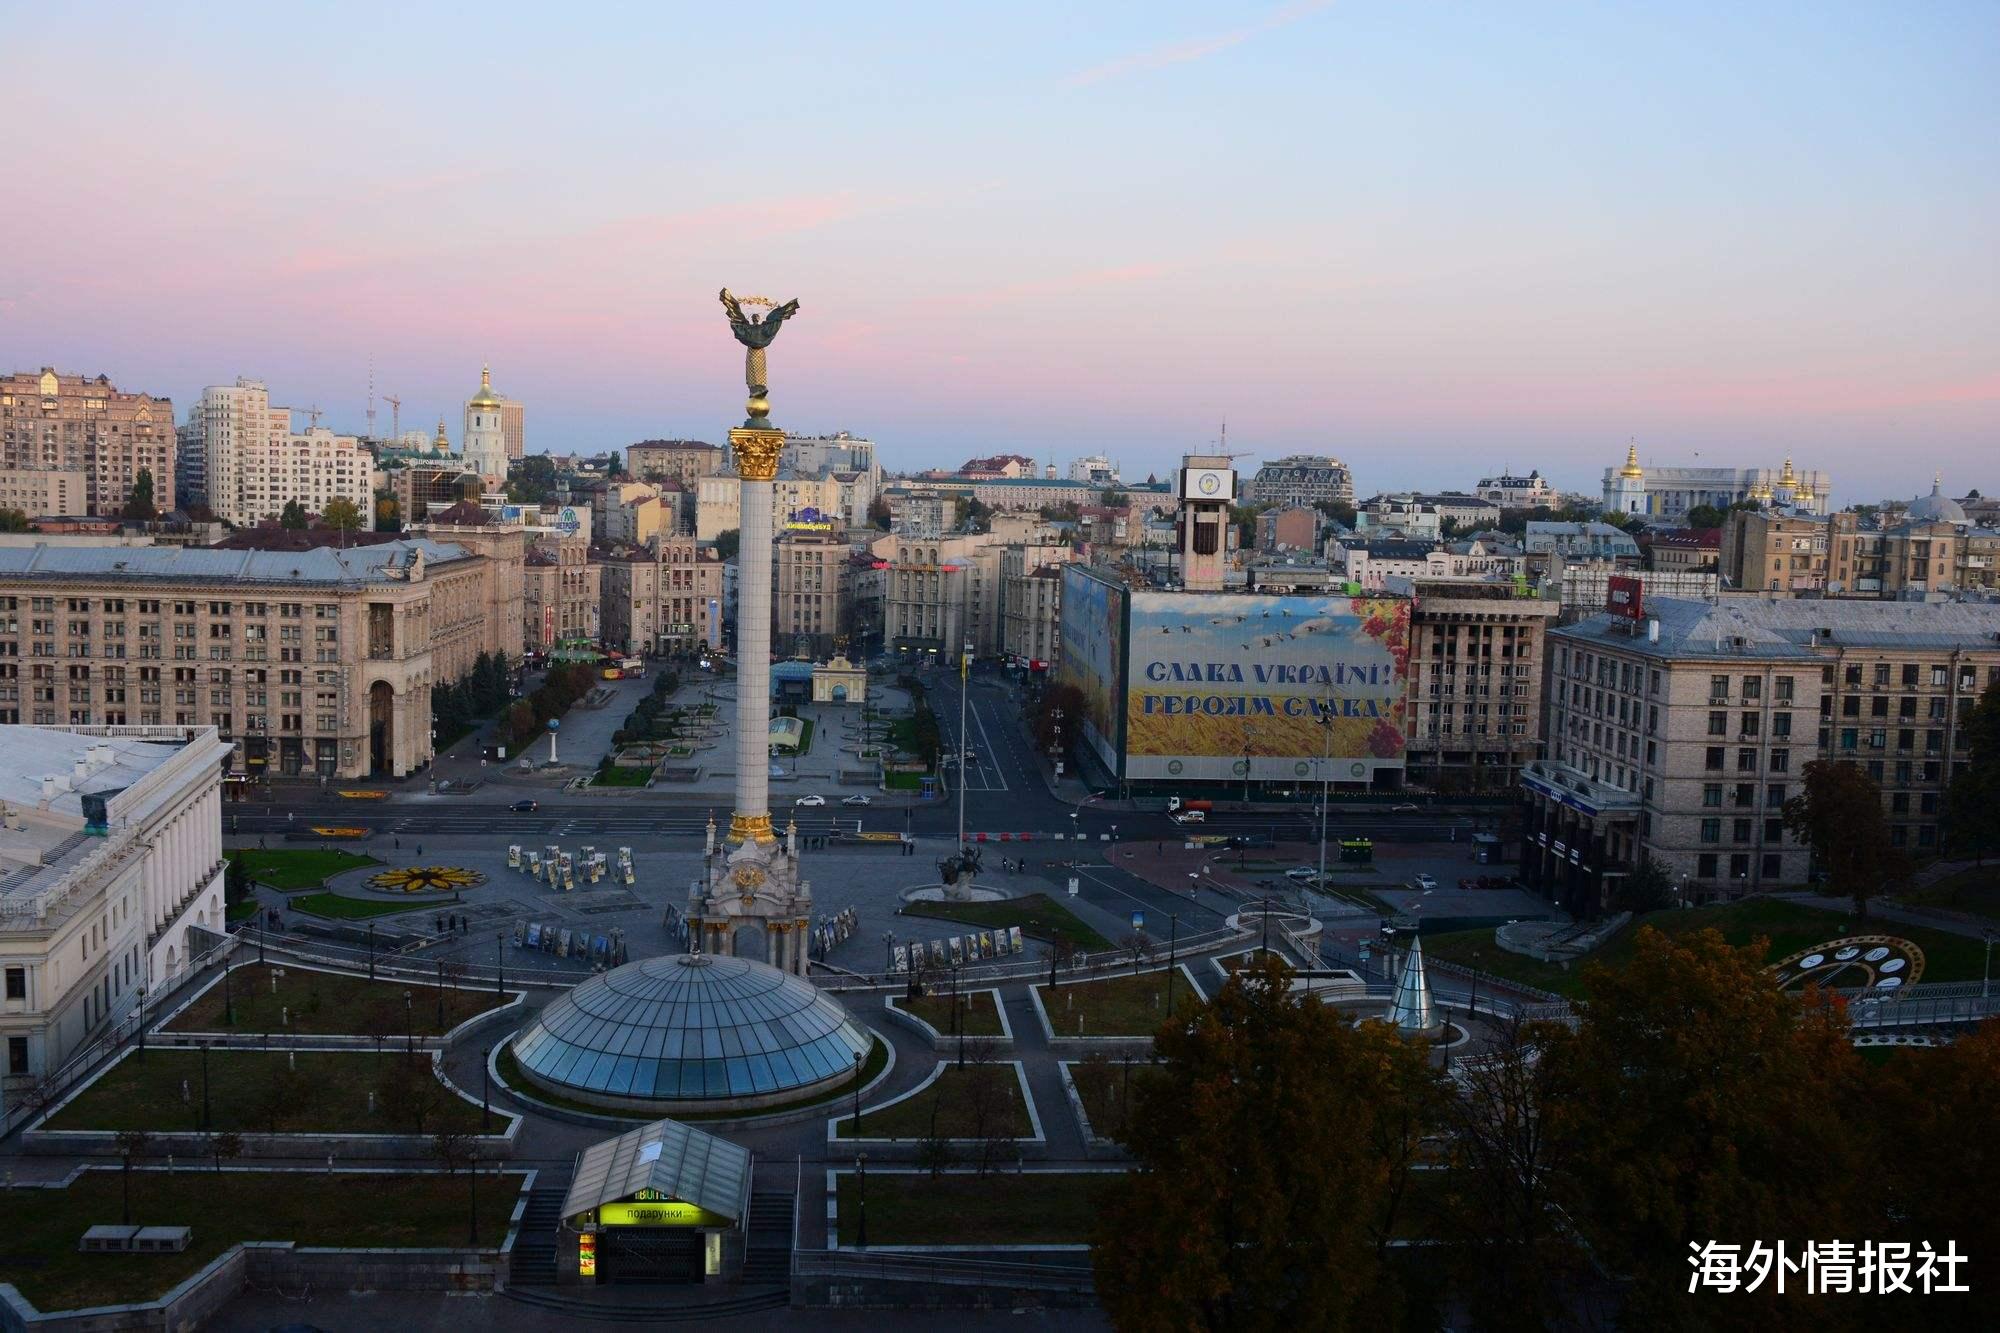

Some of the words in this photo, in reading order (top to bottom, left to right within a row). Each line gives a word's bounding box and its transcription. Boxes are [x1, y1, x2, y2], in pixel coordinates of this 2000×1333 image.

[1145, 661, 1244, 683] СЛАВА
[1253, 662, 1391, 685] УКРАЇНІ!
[1143, 695, 1275, 717] ГЕРОЯМ
[1283, 697, 1391, 719] СЛАВА!
[627, 1209, 682, 1220] подарунки
